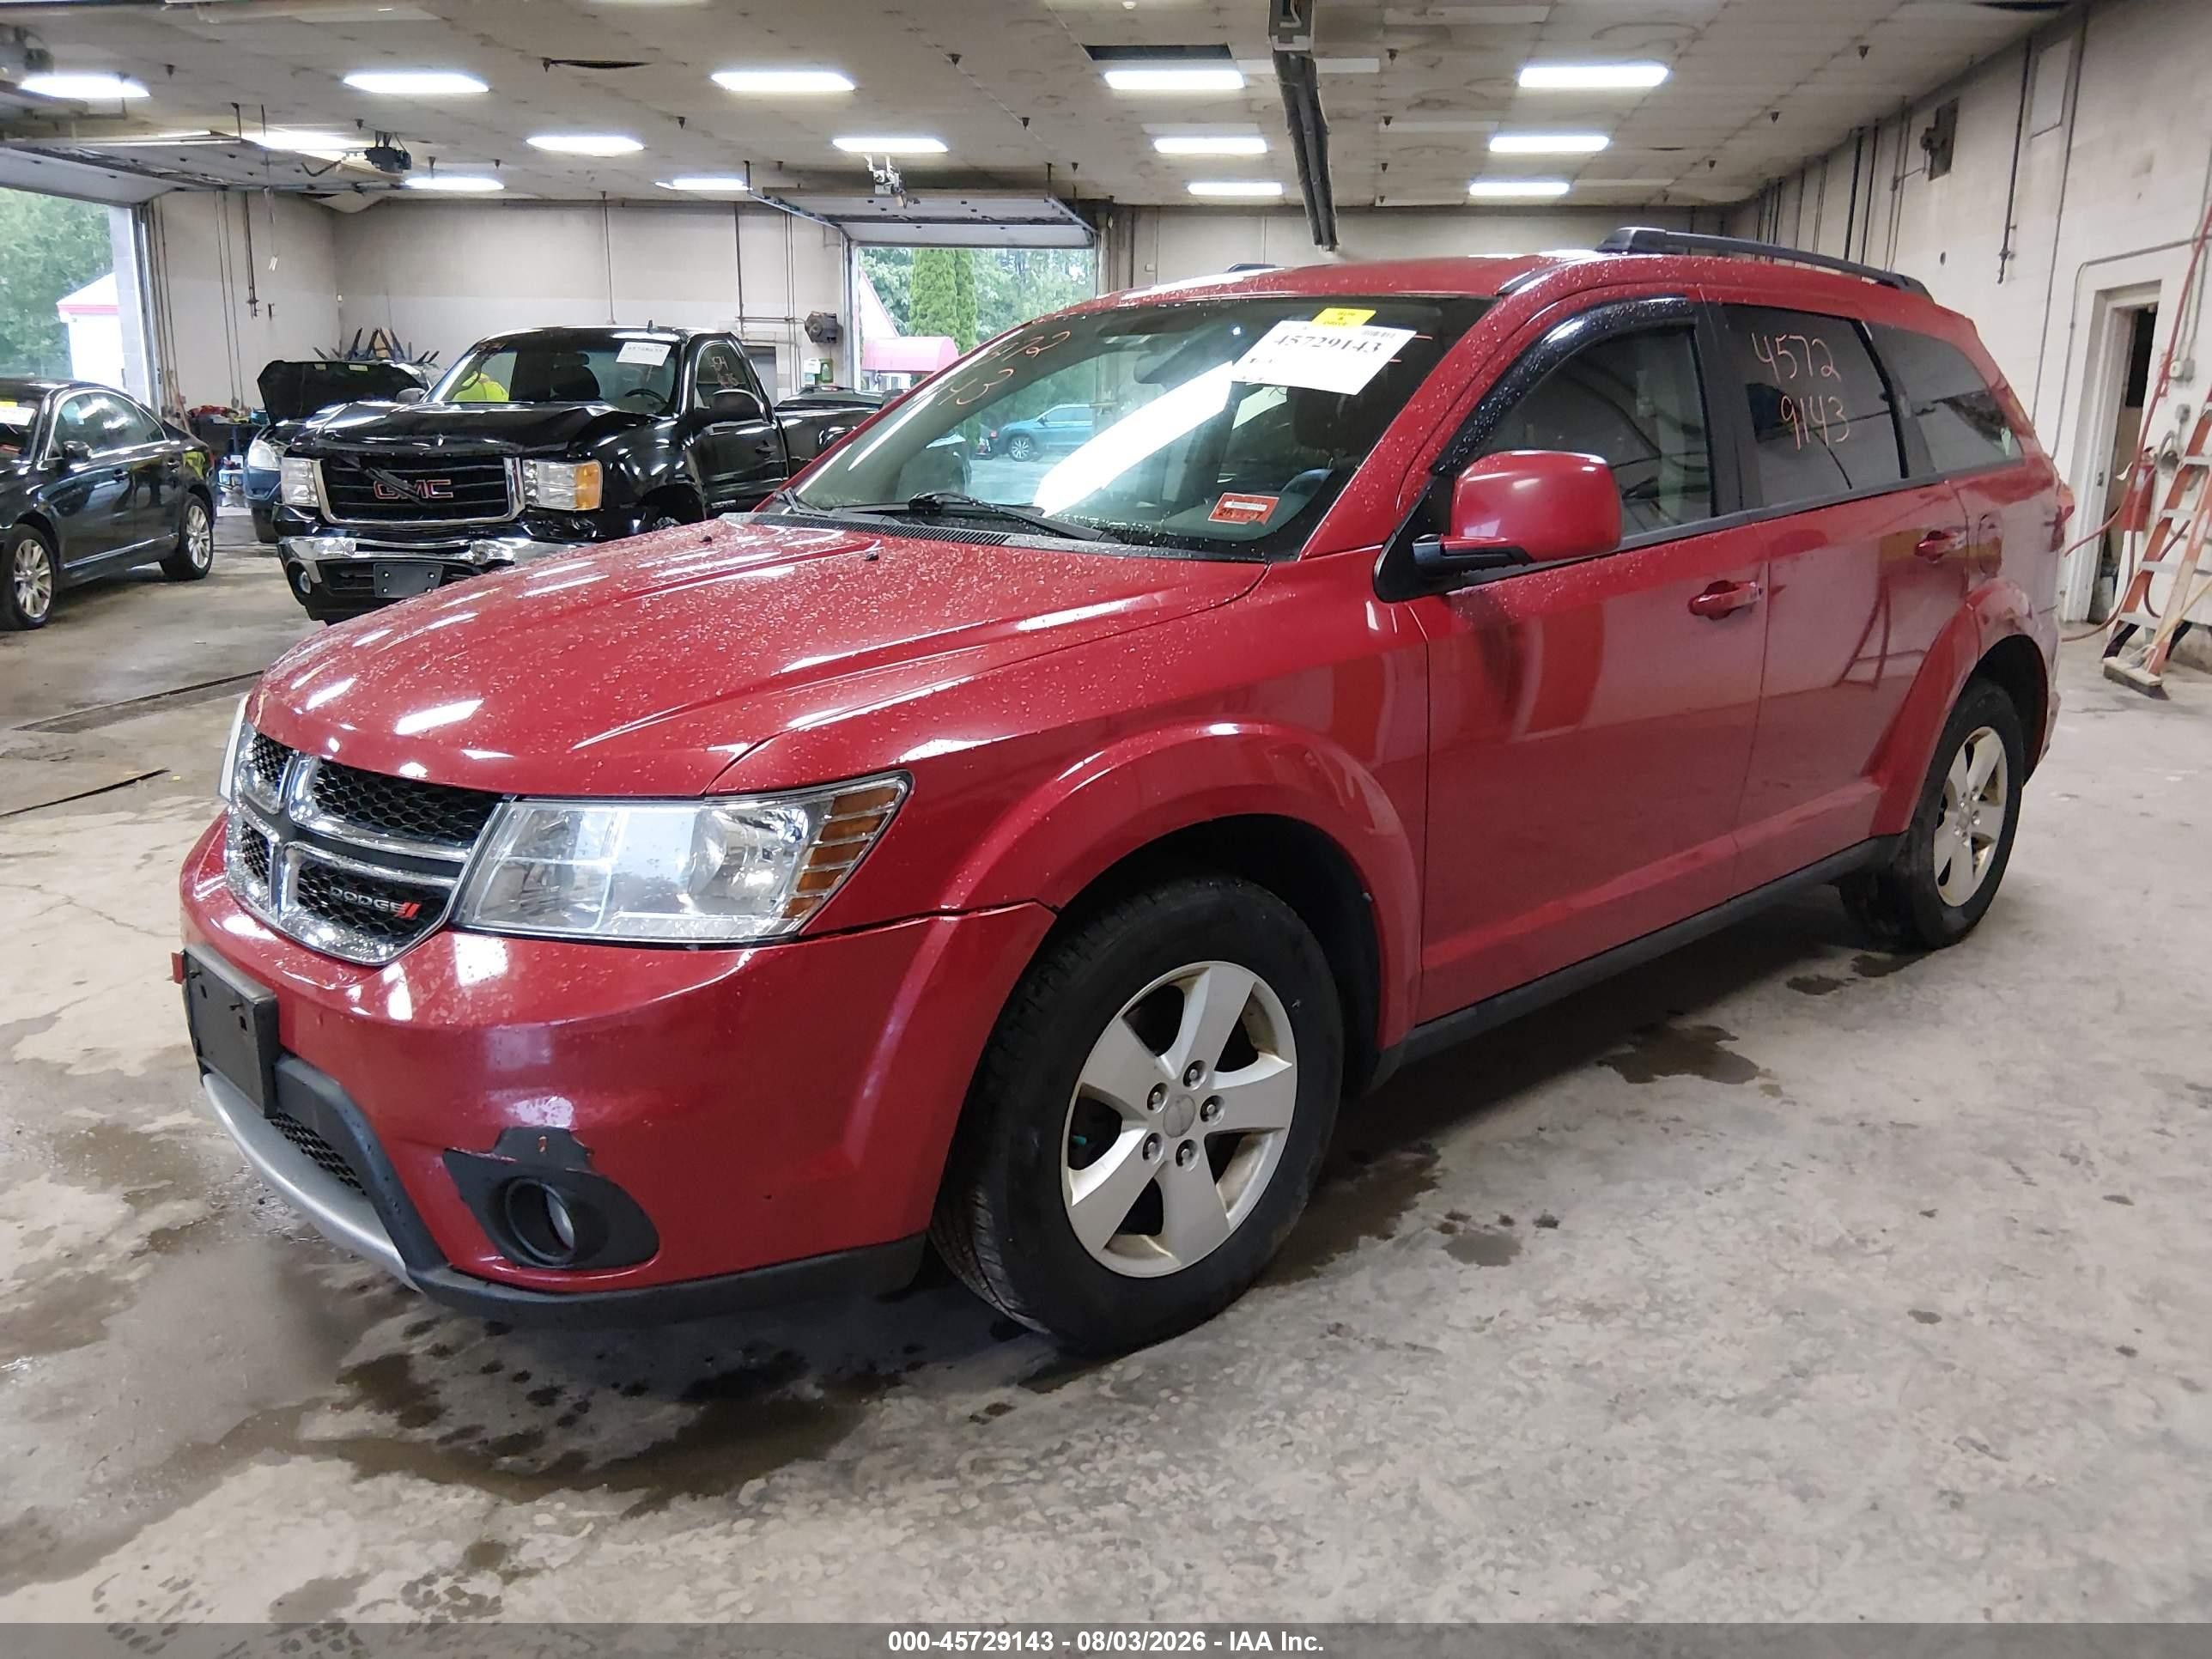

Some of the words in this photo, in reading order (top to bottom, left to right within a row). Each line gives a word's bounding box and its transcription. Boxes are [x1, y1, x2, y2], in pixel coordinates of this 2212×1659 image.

[1273, 334, 1382, 354] 45729143
[1751, 332, 1842, 385] 4572
[1780, 395, 1850, 451] 9143
[330, 885, 407, 915] DODGE
